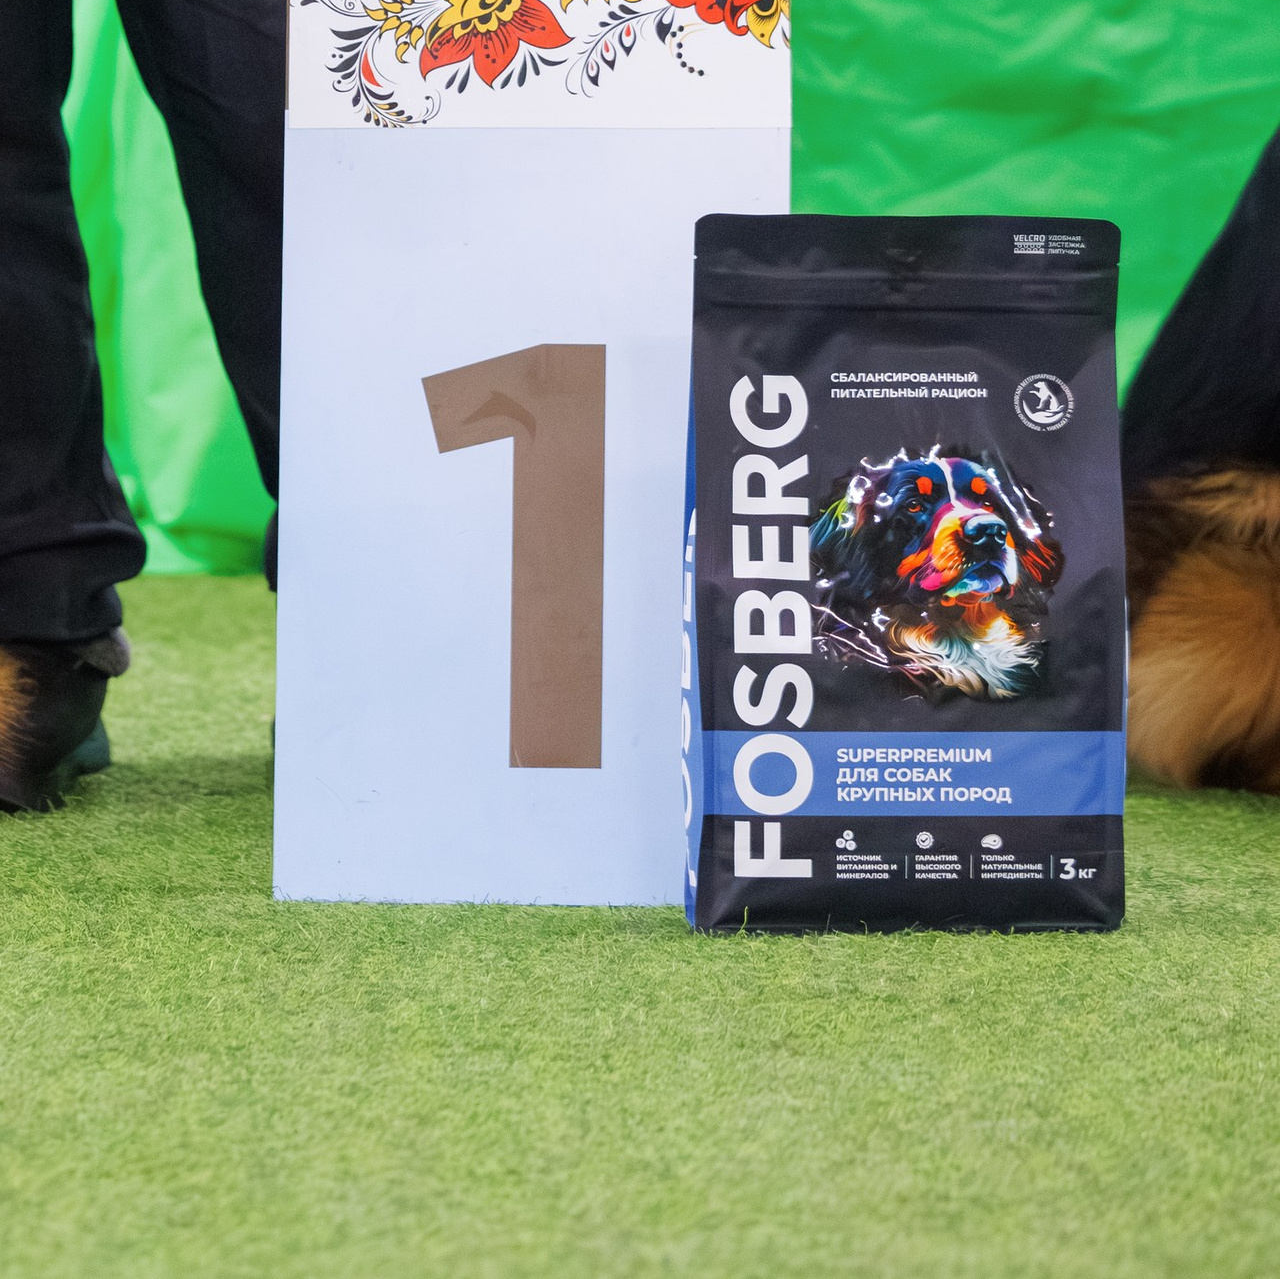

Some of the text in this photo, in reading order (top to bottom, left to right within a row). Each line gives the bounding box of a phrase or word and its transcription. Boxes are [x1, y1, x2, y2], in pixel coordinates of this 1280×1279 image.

[1013, 234, 1046, 242] VELCRO
[830, 371, 979, 383] СБАЛАНСИРОВАННЫЙ
[830, 386, 988, 399] ПИТАТЕЛЬНЫЙ РАЦИОН
[421, 343, 607, 769] 1
[729, 375, 814, 879] FOSBERG
[836, 748, 992, 763] SUPERPREMIUM
[836, 767, 953, 784] ДЛЯ СОБАК
[836, 787, 1013, 804] КРУПНЫХ ПОРОД
[836, 854, 882, 862] ИСТОЧНИК
[915, 854, 959, 862] ГАРАНТИЯ
[981, 854, 1016, 862] ТОЛЬКО
[1059, 858, 1076, 880] 3
[981, 872, 1043, 880] ИНГРЕДИЕНТЫ
